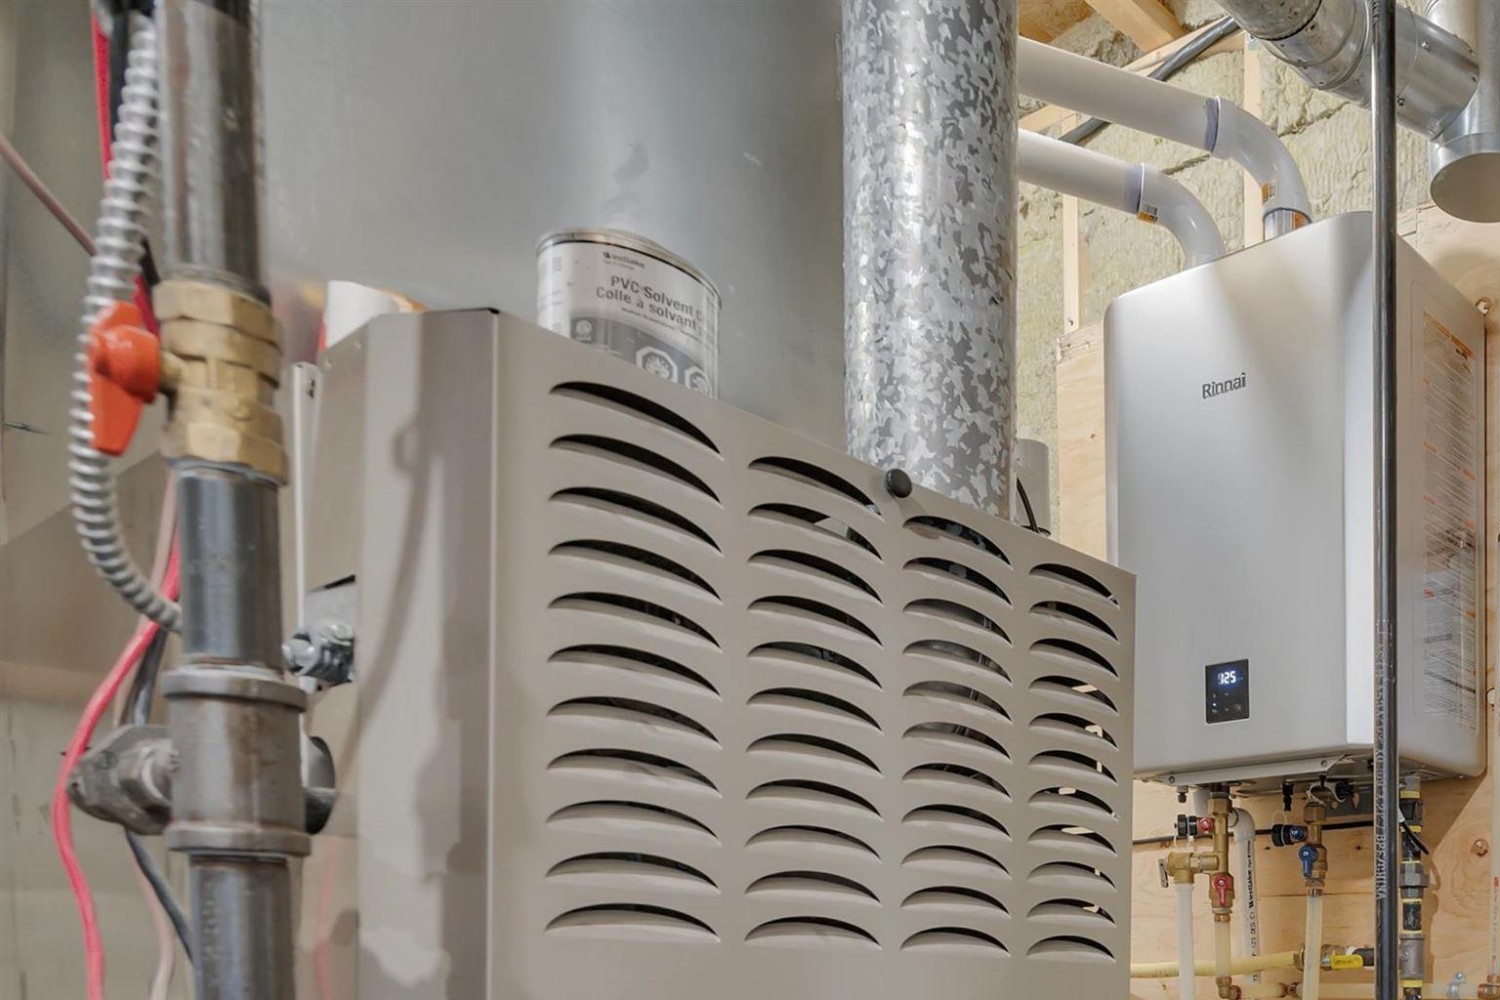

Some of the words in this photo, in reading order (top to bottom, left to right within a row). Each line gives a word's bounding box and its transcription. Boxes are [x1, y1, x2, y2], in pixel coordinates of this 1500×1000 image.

[596, 286, 632, 304] Colle
[648, 304, 696, 329] solvant
[611, 275, 640, 294] PVC
[644, 286, 694, 316] Solvent
[1201, 372, 1248, 400] Rinnai
